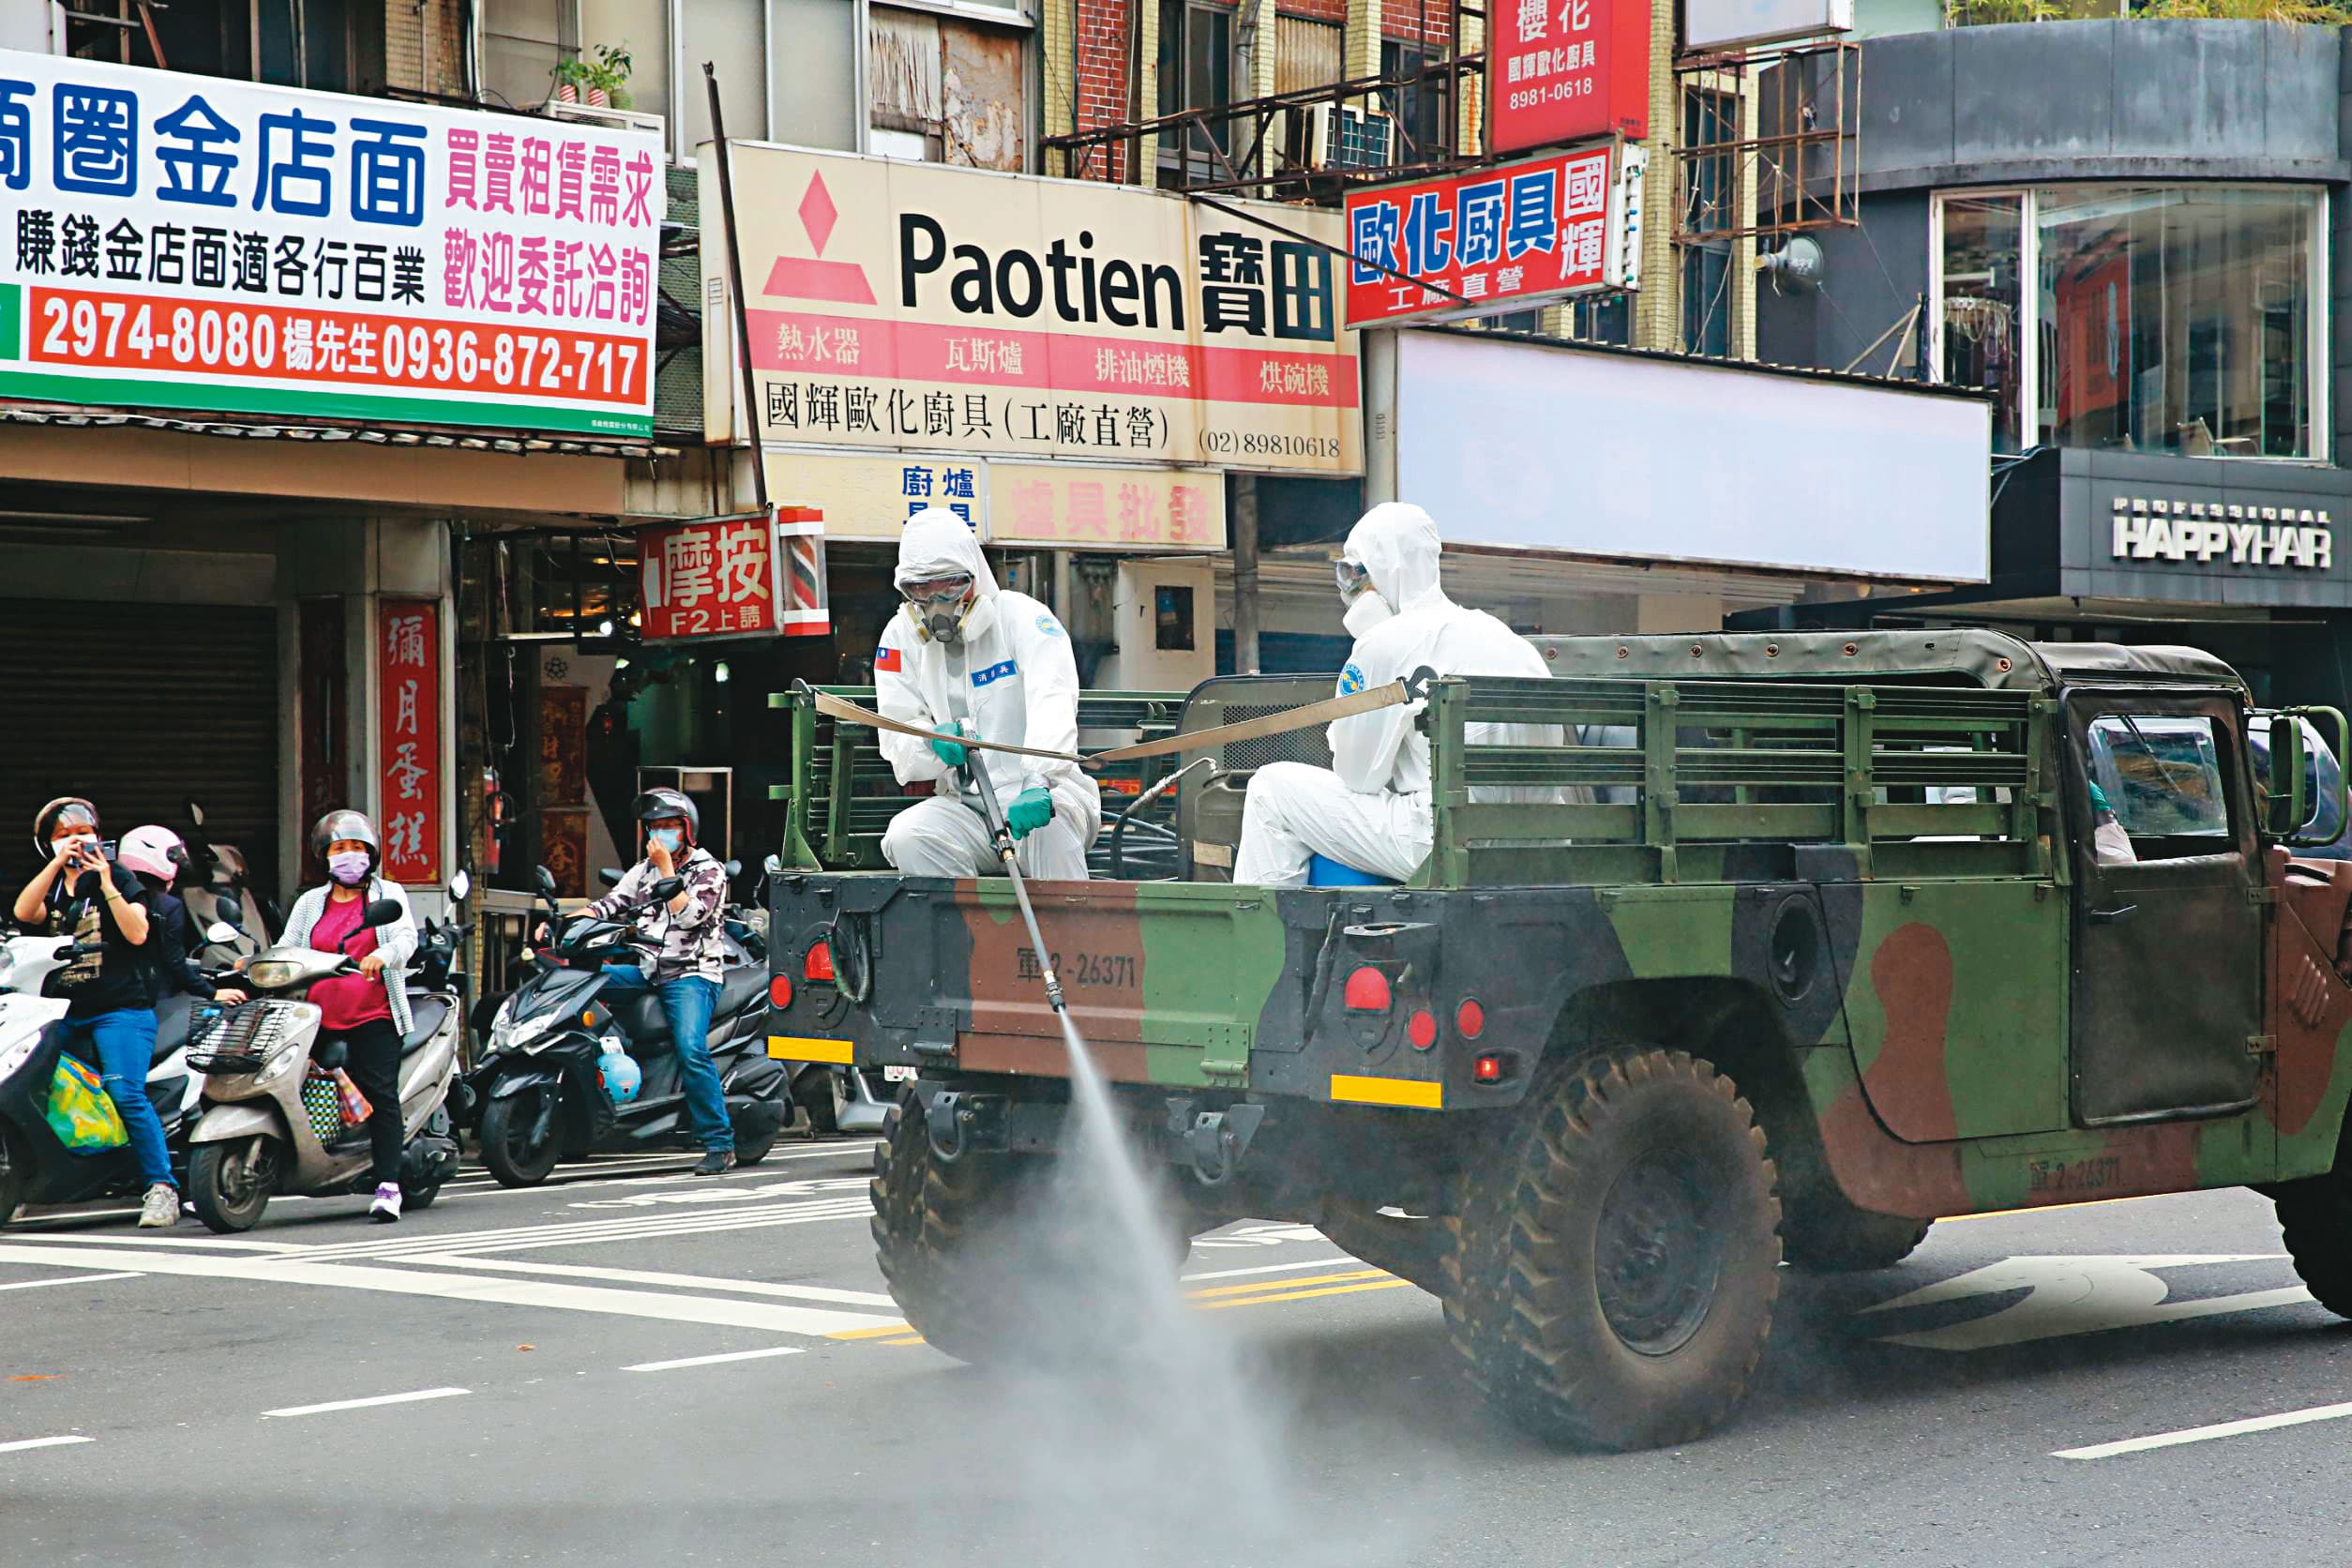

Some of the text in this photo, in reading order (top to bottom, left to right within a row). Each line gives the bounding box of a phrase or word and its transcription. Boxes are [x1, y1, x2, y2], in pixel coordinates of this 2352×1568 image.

[1510, 78, 1592, 110] 8981-0618
[445, 128, 652, 228] 買賣租賃需求
[1560, 155, 1606, 280] 國輝
[15, 208, 425, 306] 賺錢金店面適各行百業
[443, 227, 651, 326] 歡迎委託洽詢
[899, 214, 1184, 330] Paotien
[1199, 232, 1335, 342] 寶田
[1387, 265, 1524, 311] 工廠直營
[42, 296, 639, 396] 2974-8080 楊先生 0936-872-717
[776, 324, 860, 365] 熱水器
[944, 338, 1024, 375] 瓦斯爐
[1259, 360, 1330, 397] 烘碗機
[1199, 428, 1341, 459] (02)89810618
[2113, 497, 2331, 524] PROFESSIONAL
[386, 615, 429, 866] 彌月蛋糕
